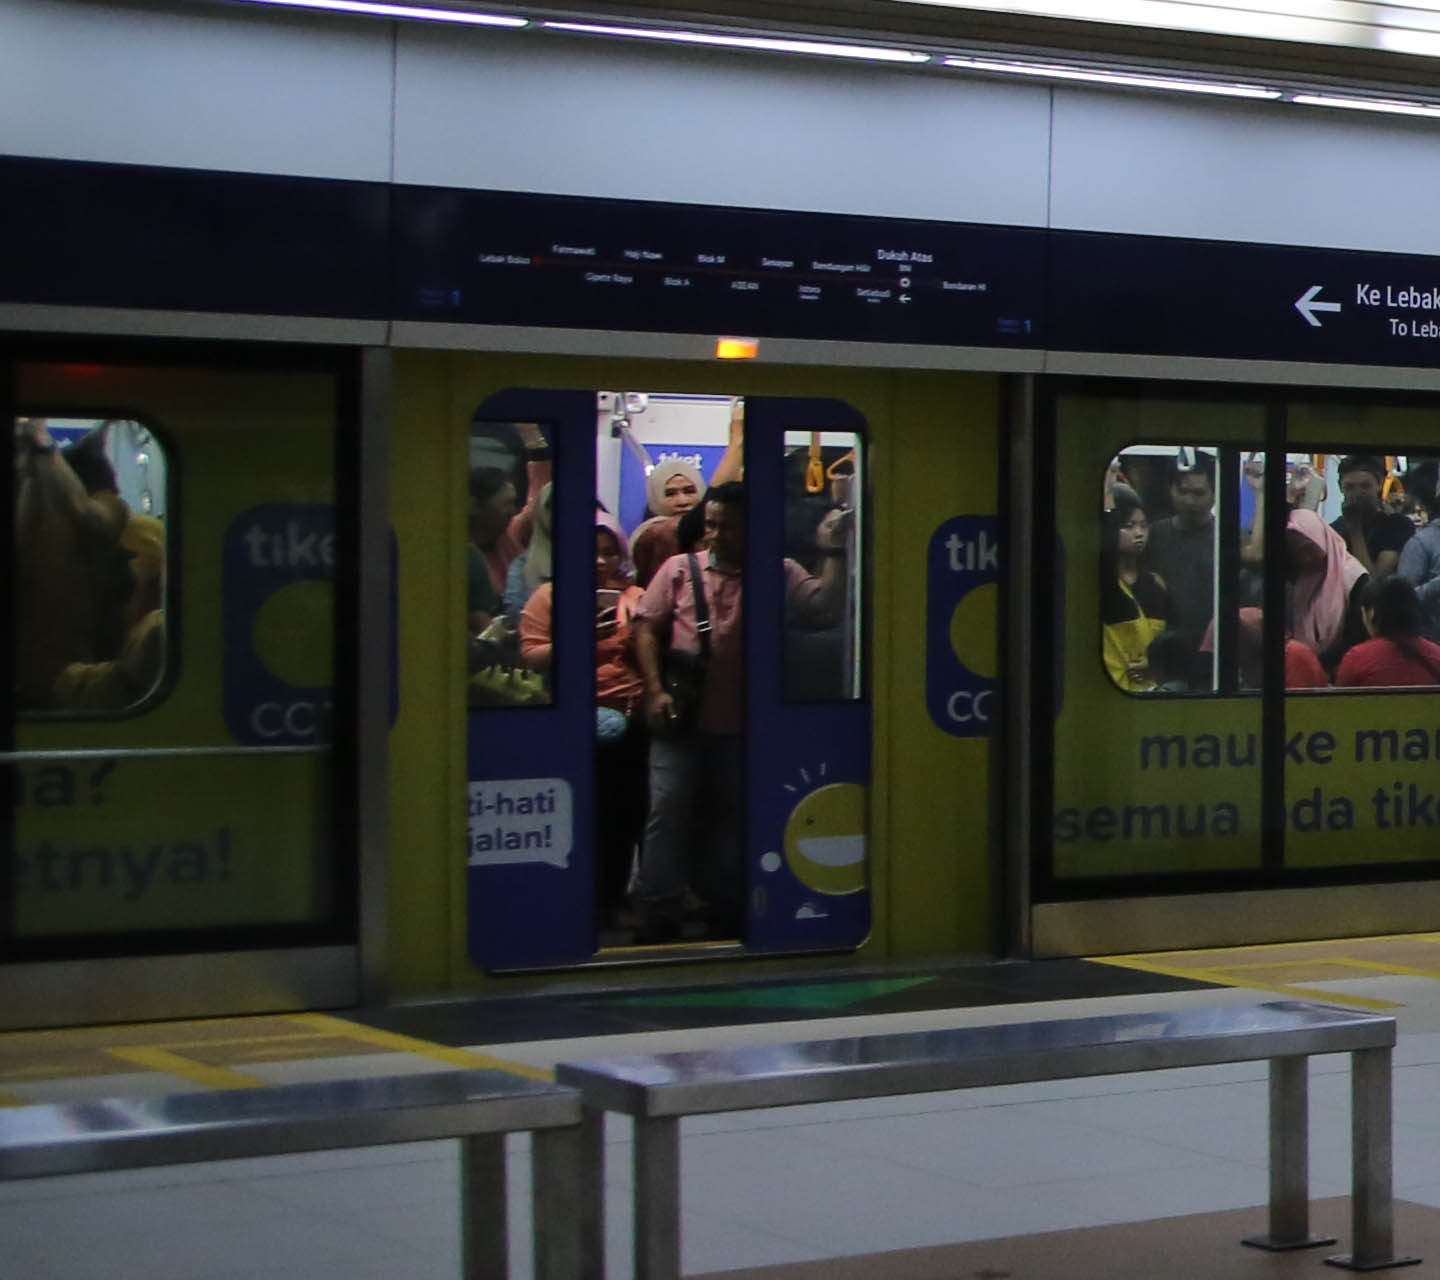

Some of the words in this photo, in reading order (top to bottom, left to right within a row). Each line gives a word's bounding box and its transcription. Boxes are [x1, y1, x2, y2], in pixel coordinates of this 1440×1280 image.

[1356, 283, 1381, 307] Ke
[1389, 318, 1408, 337] To
[1139, 728, 1256, 771] mau
[1052, 799, 1240, 845] semua
[1277, 786, 1354, 834] da
